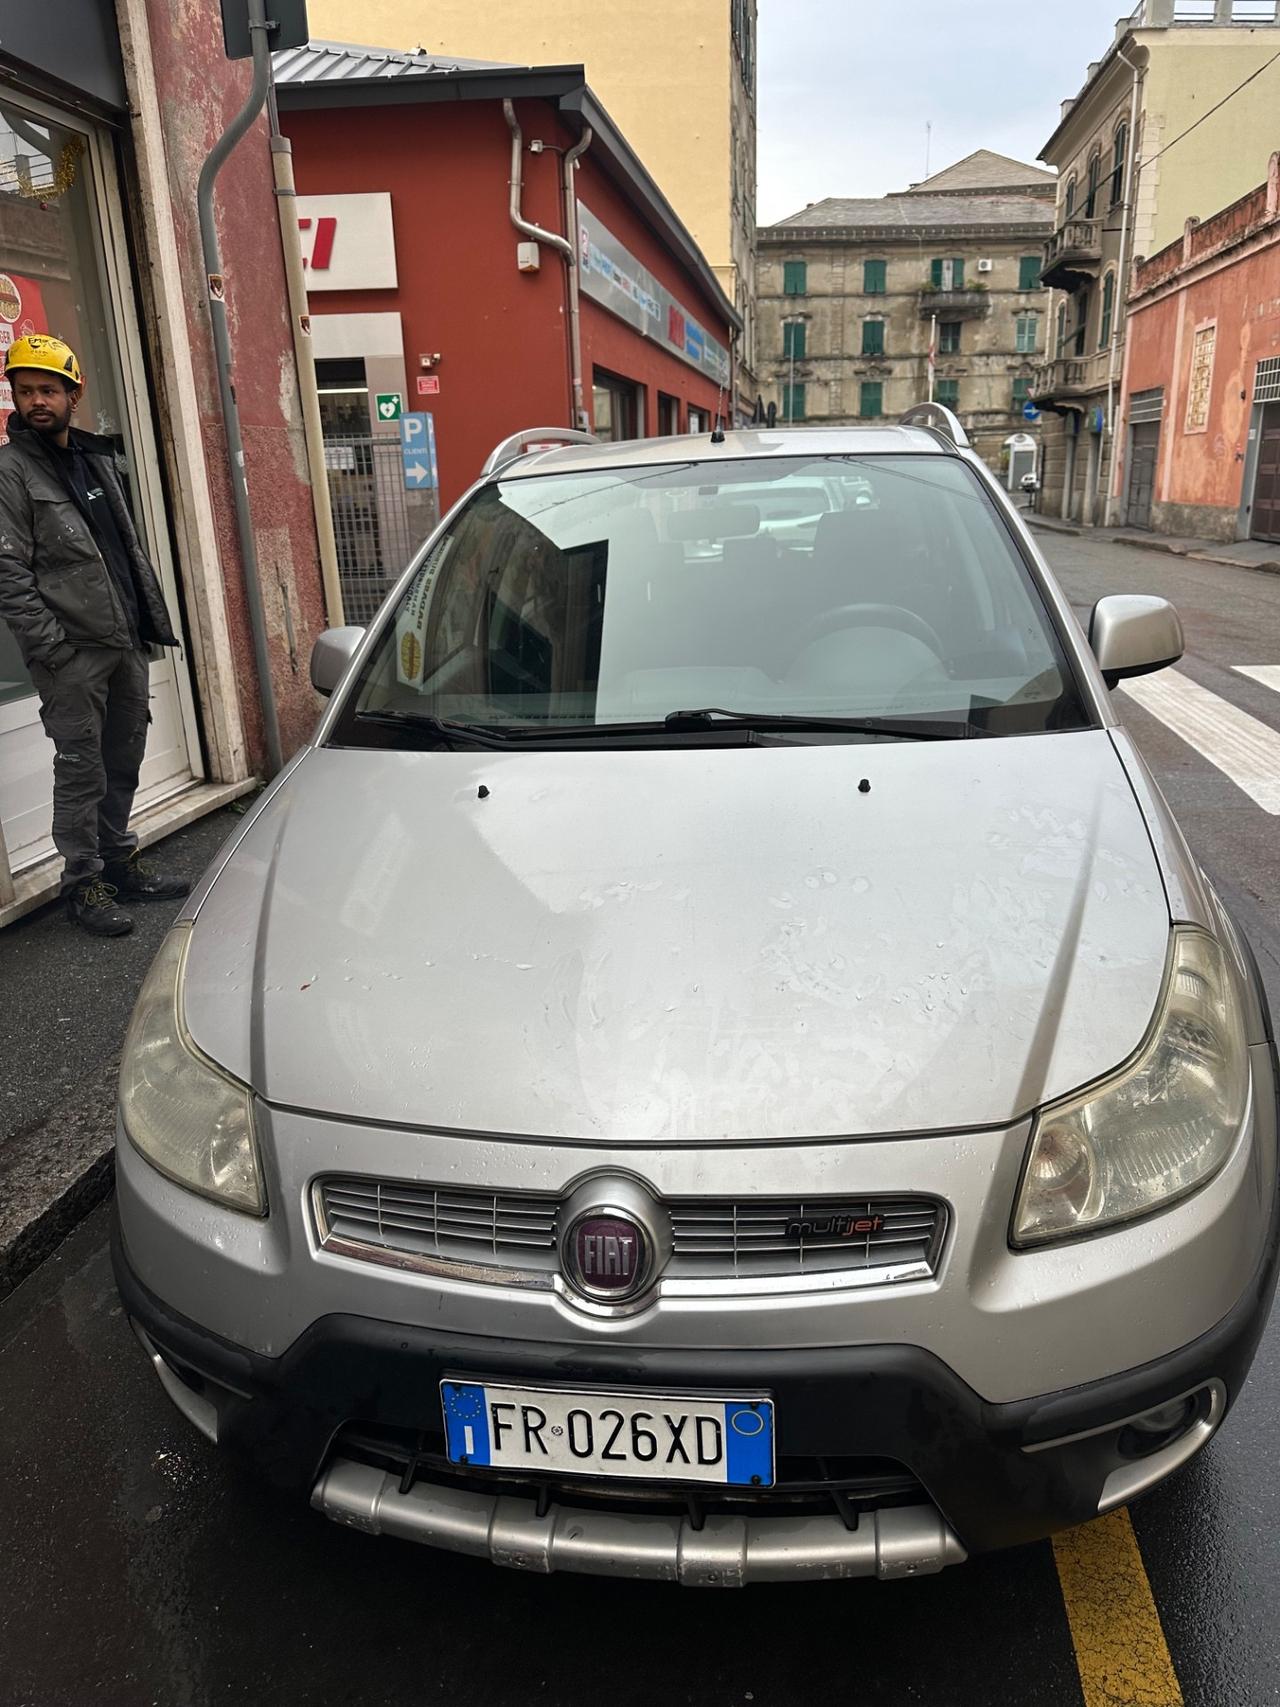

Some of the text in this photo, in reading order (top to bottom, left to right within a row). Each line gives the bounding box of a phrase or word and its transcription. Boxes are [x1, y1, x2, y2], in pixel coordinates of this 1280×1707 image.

[403, 418, 422, 442] P
[788, 1216, 883, 1236] multijet
[584, 1235, 633, 1276] FIAT
[490, 1402, 723, 1466] FR 026XD
